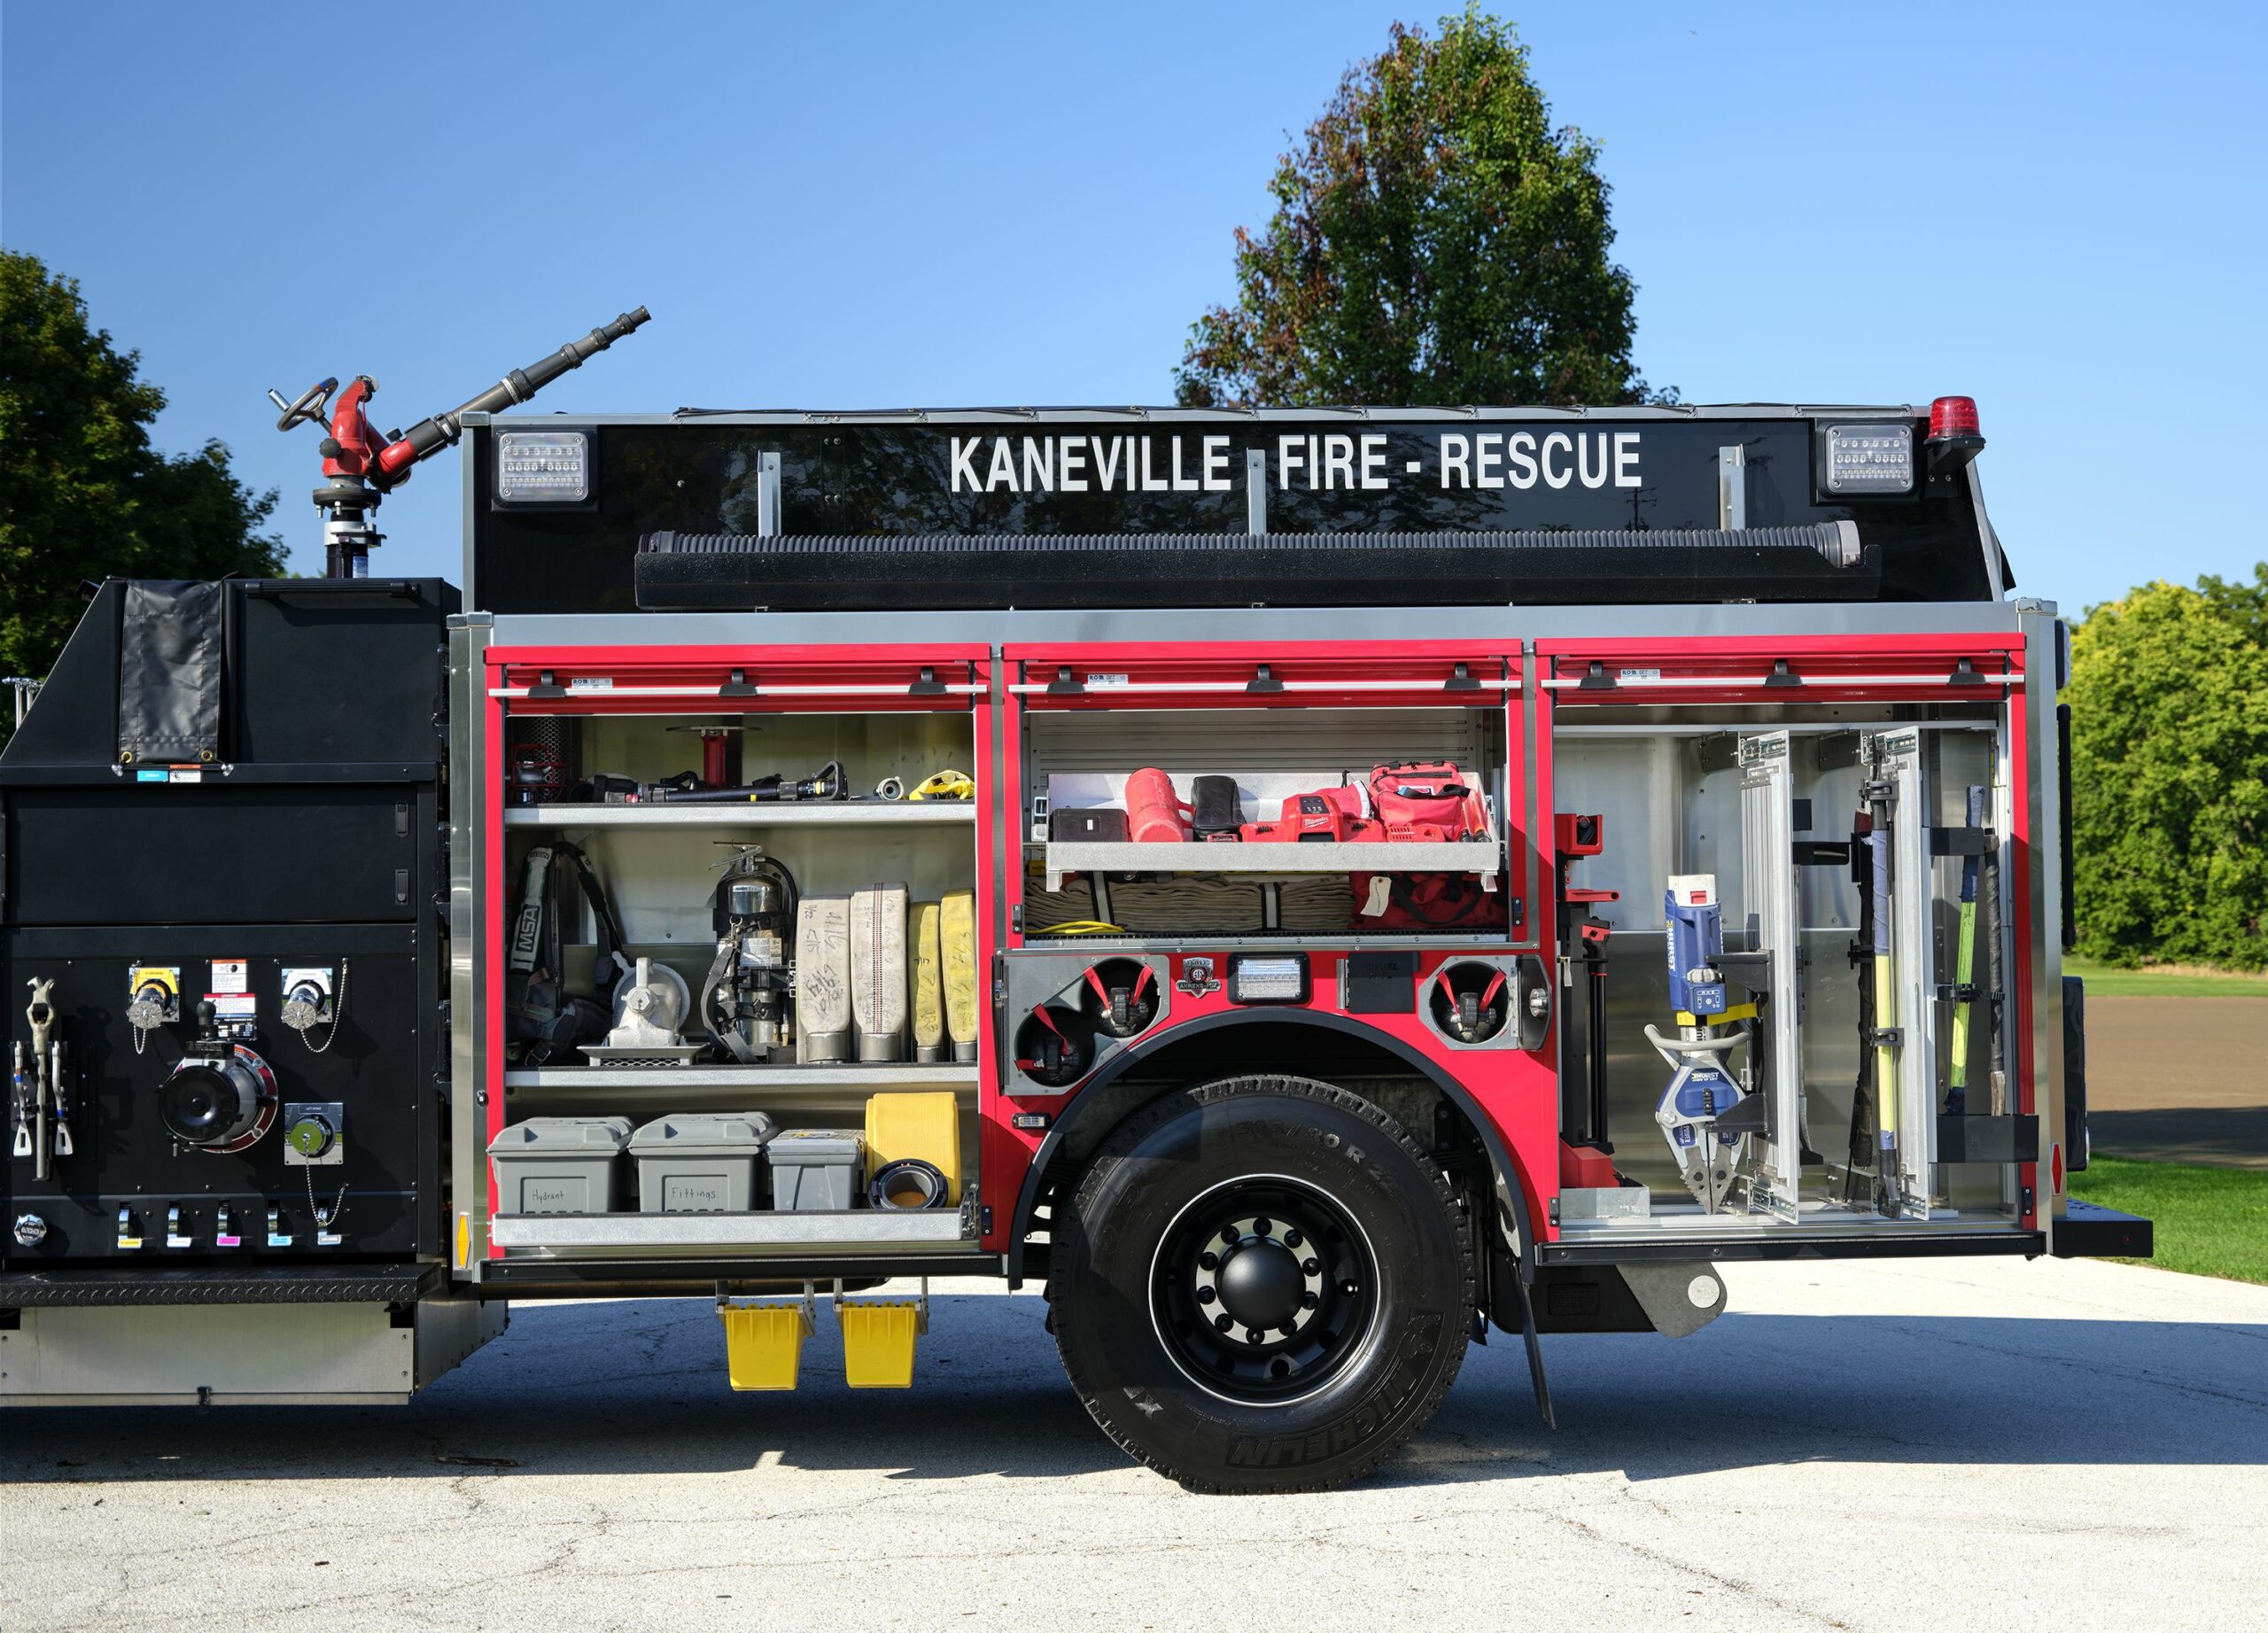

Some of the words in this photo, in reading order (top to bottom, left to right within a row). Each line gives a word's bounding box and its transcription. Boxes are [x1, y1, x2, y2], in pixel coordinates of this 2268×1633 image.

[951, 435, 1231, 493] KANEVILLE
[1278, 433, 1389, 490] FIRE
[1406, 462, 1420, 473] -
[1441, 432, 1643, 489] RESCUE
[518, 906, 539, 950] MSA
[532, 1188, 564, 1204] Hydrant
[672, 1187, 716, 1200] Fittings
[1229, 1360, 1419, 1466] MICHELIN
